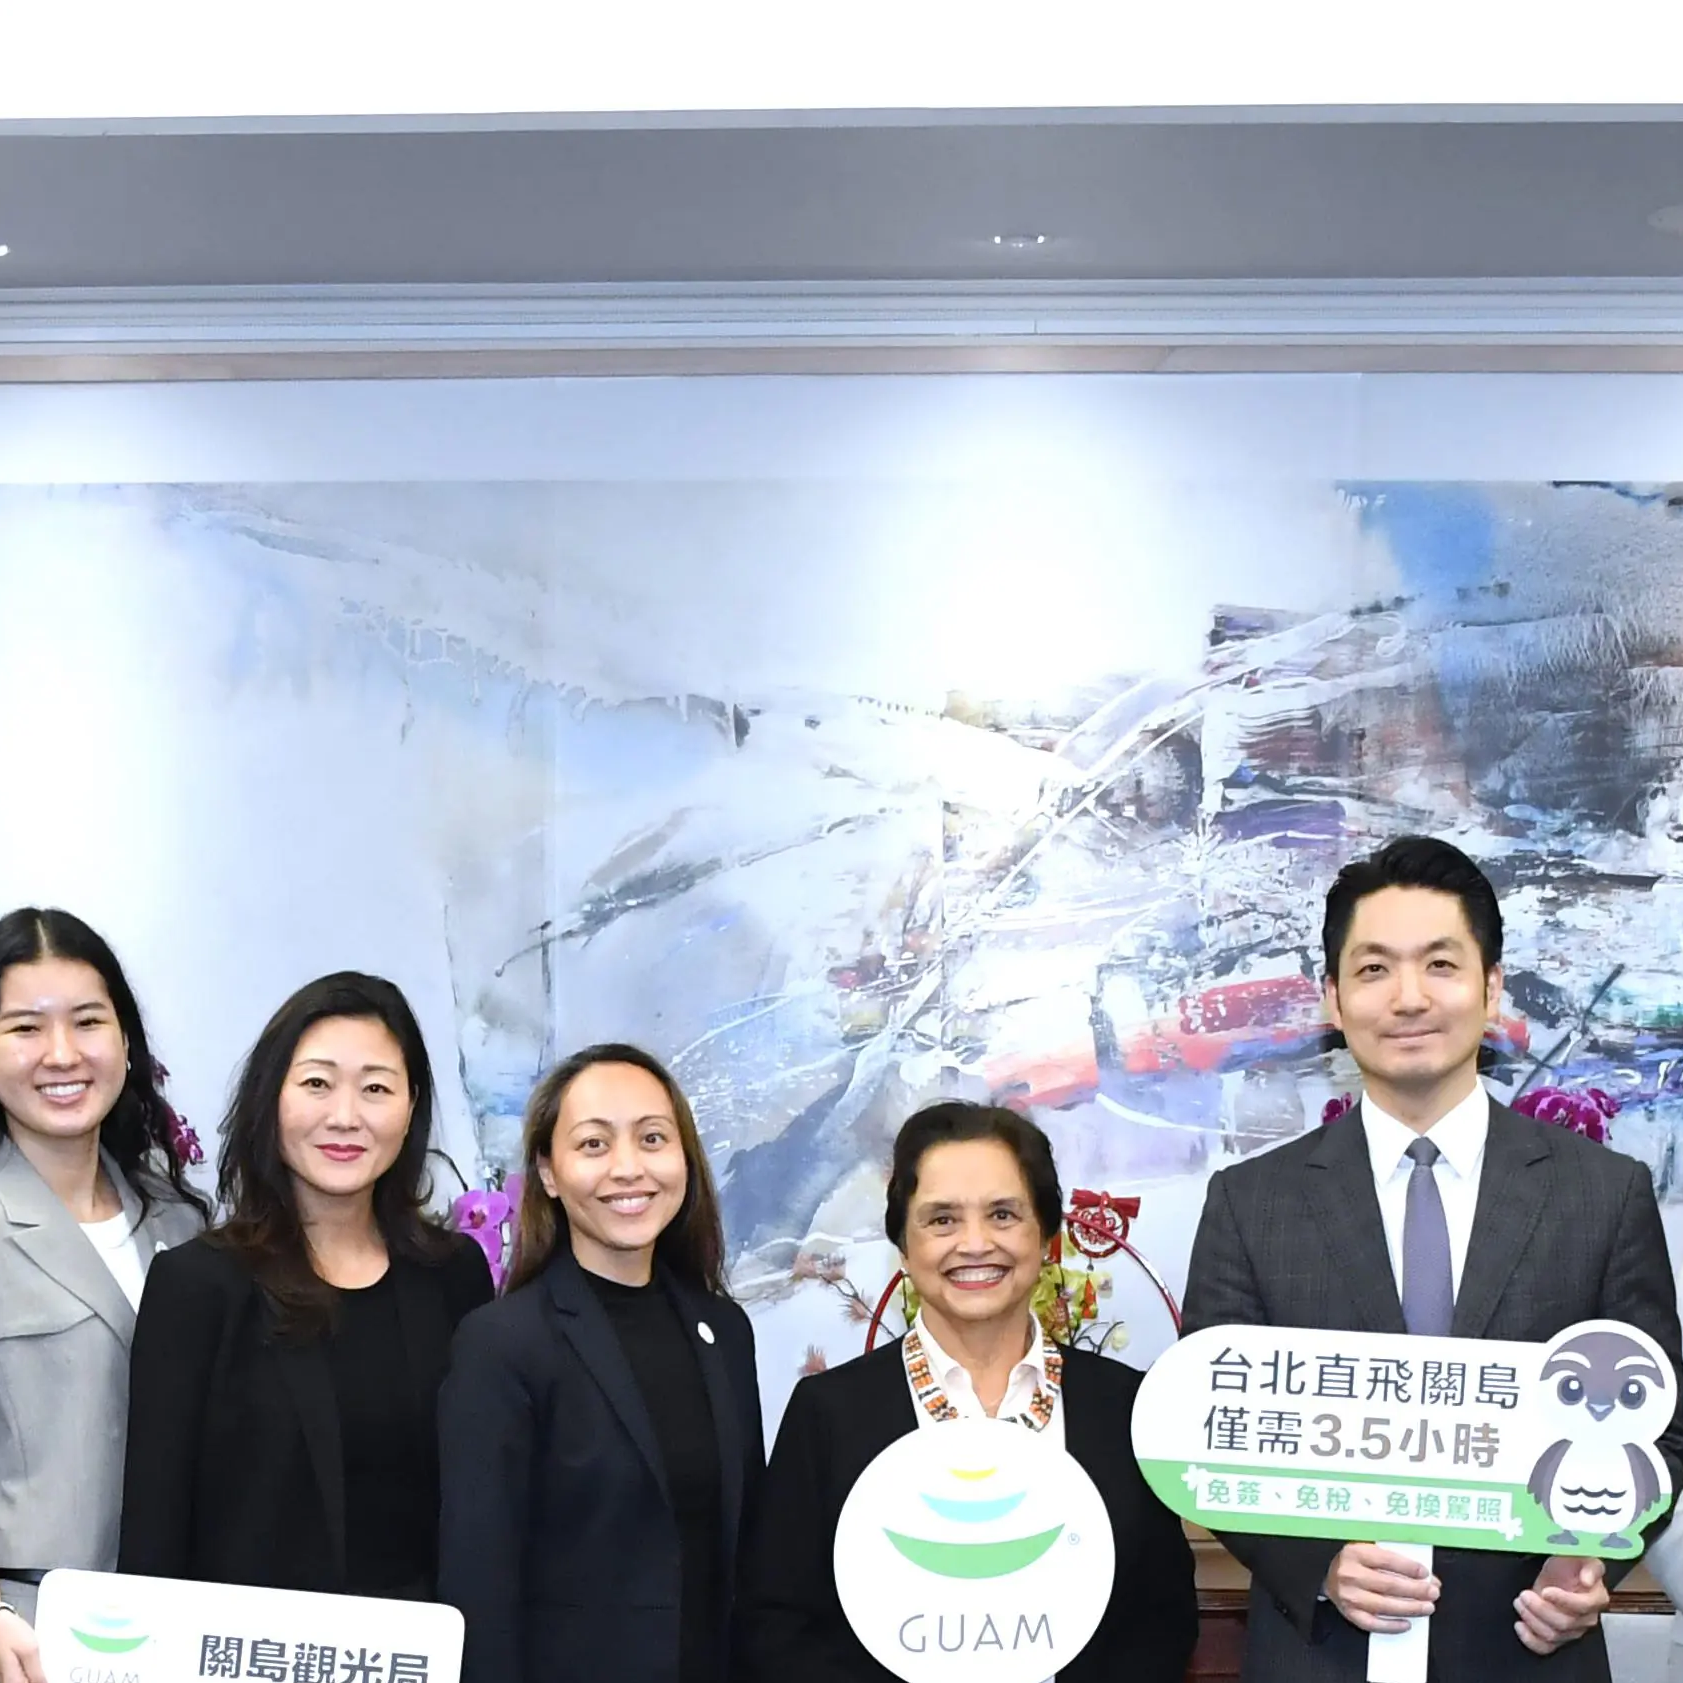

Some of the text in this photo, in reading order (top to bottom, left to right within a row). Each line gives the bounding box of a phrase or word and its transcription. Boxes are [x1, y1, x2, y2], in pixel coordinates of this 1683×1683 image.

[1209, 1346, 1520, 1410] 台北直飛關島
[1203, 1404, 1500, 1468] 僅需3.5小時
[899, 1613, 1055, 1653] GUAM
